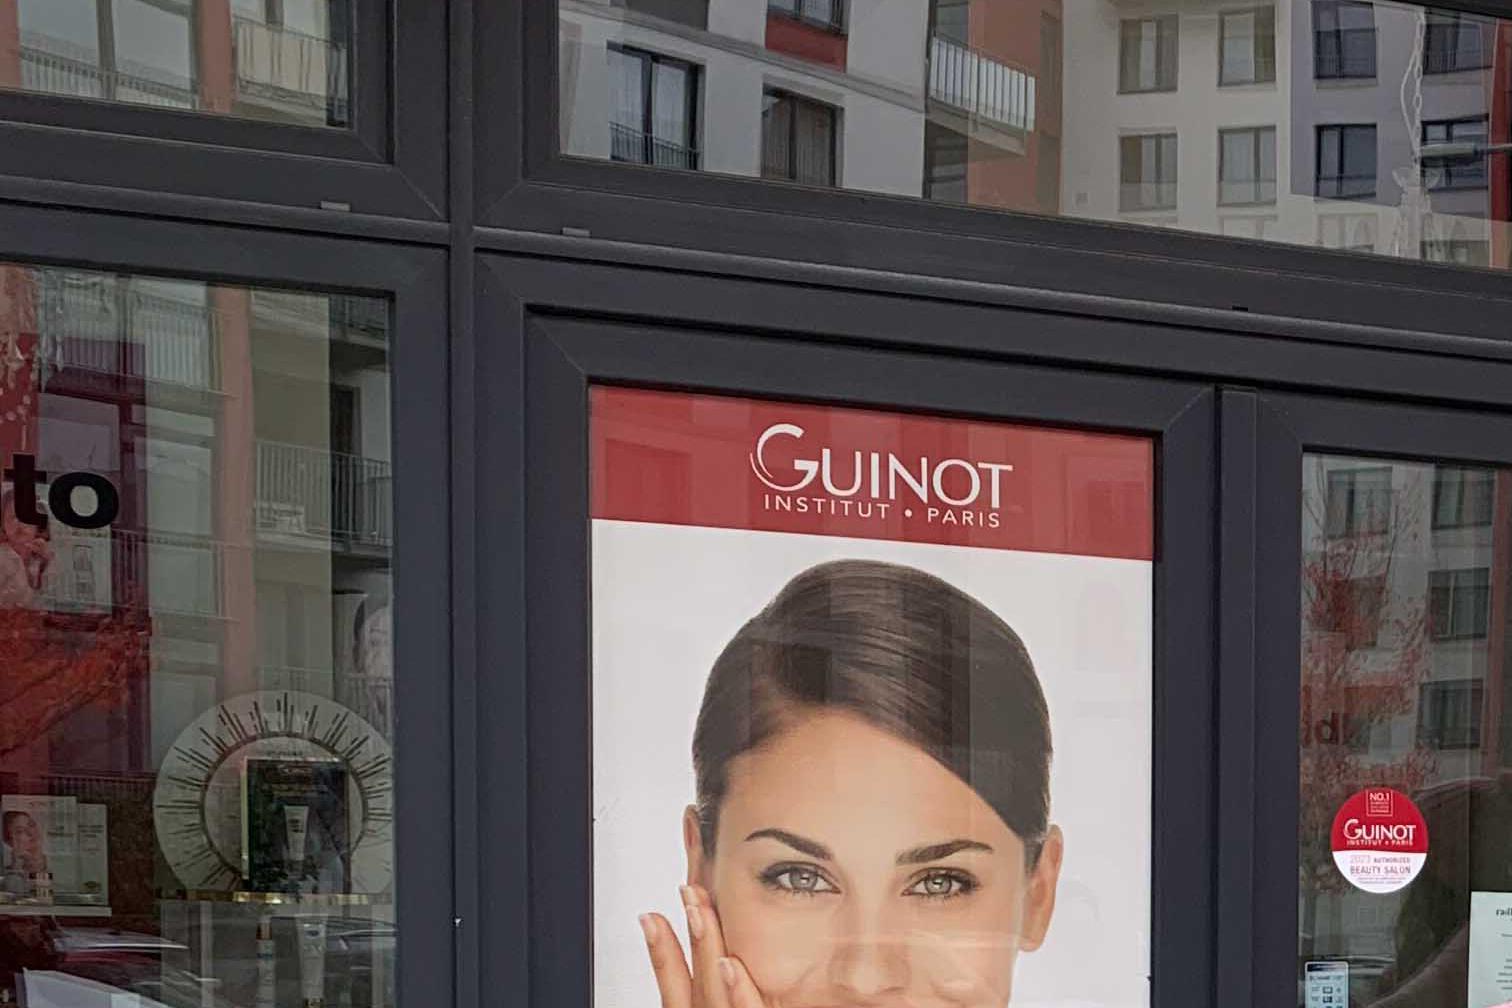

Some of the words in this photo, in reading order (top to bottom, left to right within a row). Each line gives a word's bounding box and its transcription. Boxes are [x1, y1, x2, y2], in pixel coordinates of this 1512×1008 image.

[3, 453, 120, 529] to
[750, 423, 1013, 509] GUINOT
[764, 494, 890, 519] INSTITUT
[927, 508, 1001, 528] PARIS
[1350, 865, 1381, 875] BEAUTY
[1384, 866, 1411, 874] SALON
